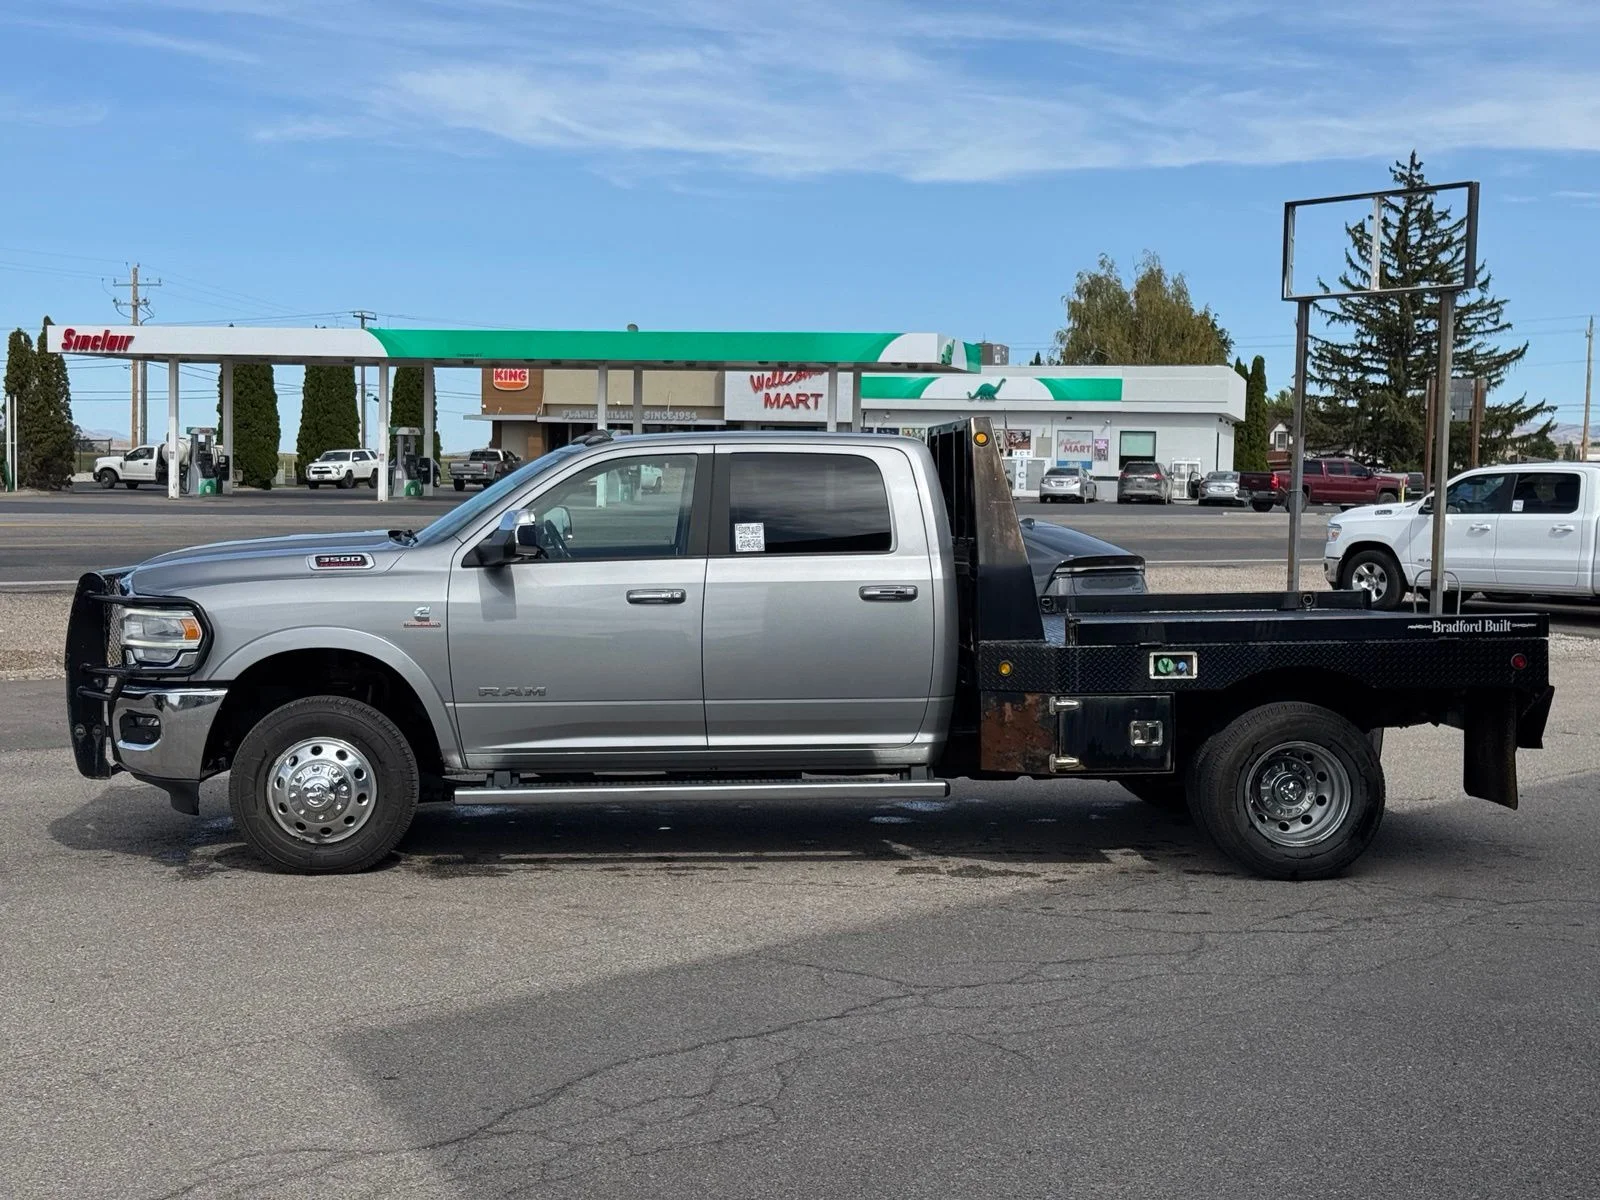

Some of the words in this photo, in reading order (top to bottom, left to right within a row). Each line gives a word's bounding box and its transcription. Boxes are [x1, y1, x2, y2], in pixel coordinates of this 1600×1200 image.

[61, 328, 135, 351] Sinclair
[495, 370, 527, 381] KING
[764, 392, 823, 410] MART
[1063, 444, 1092, 453] MART
[1432, 620, 1482, 633] Bradford
[1484, 620, 1511, 632] Built
[478, 686, 546, 697] RAM
